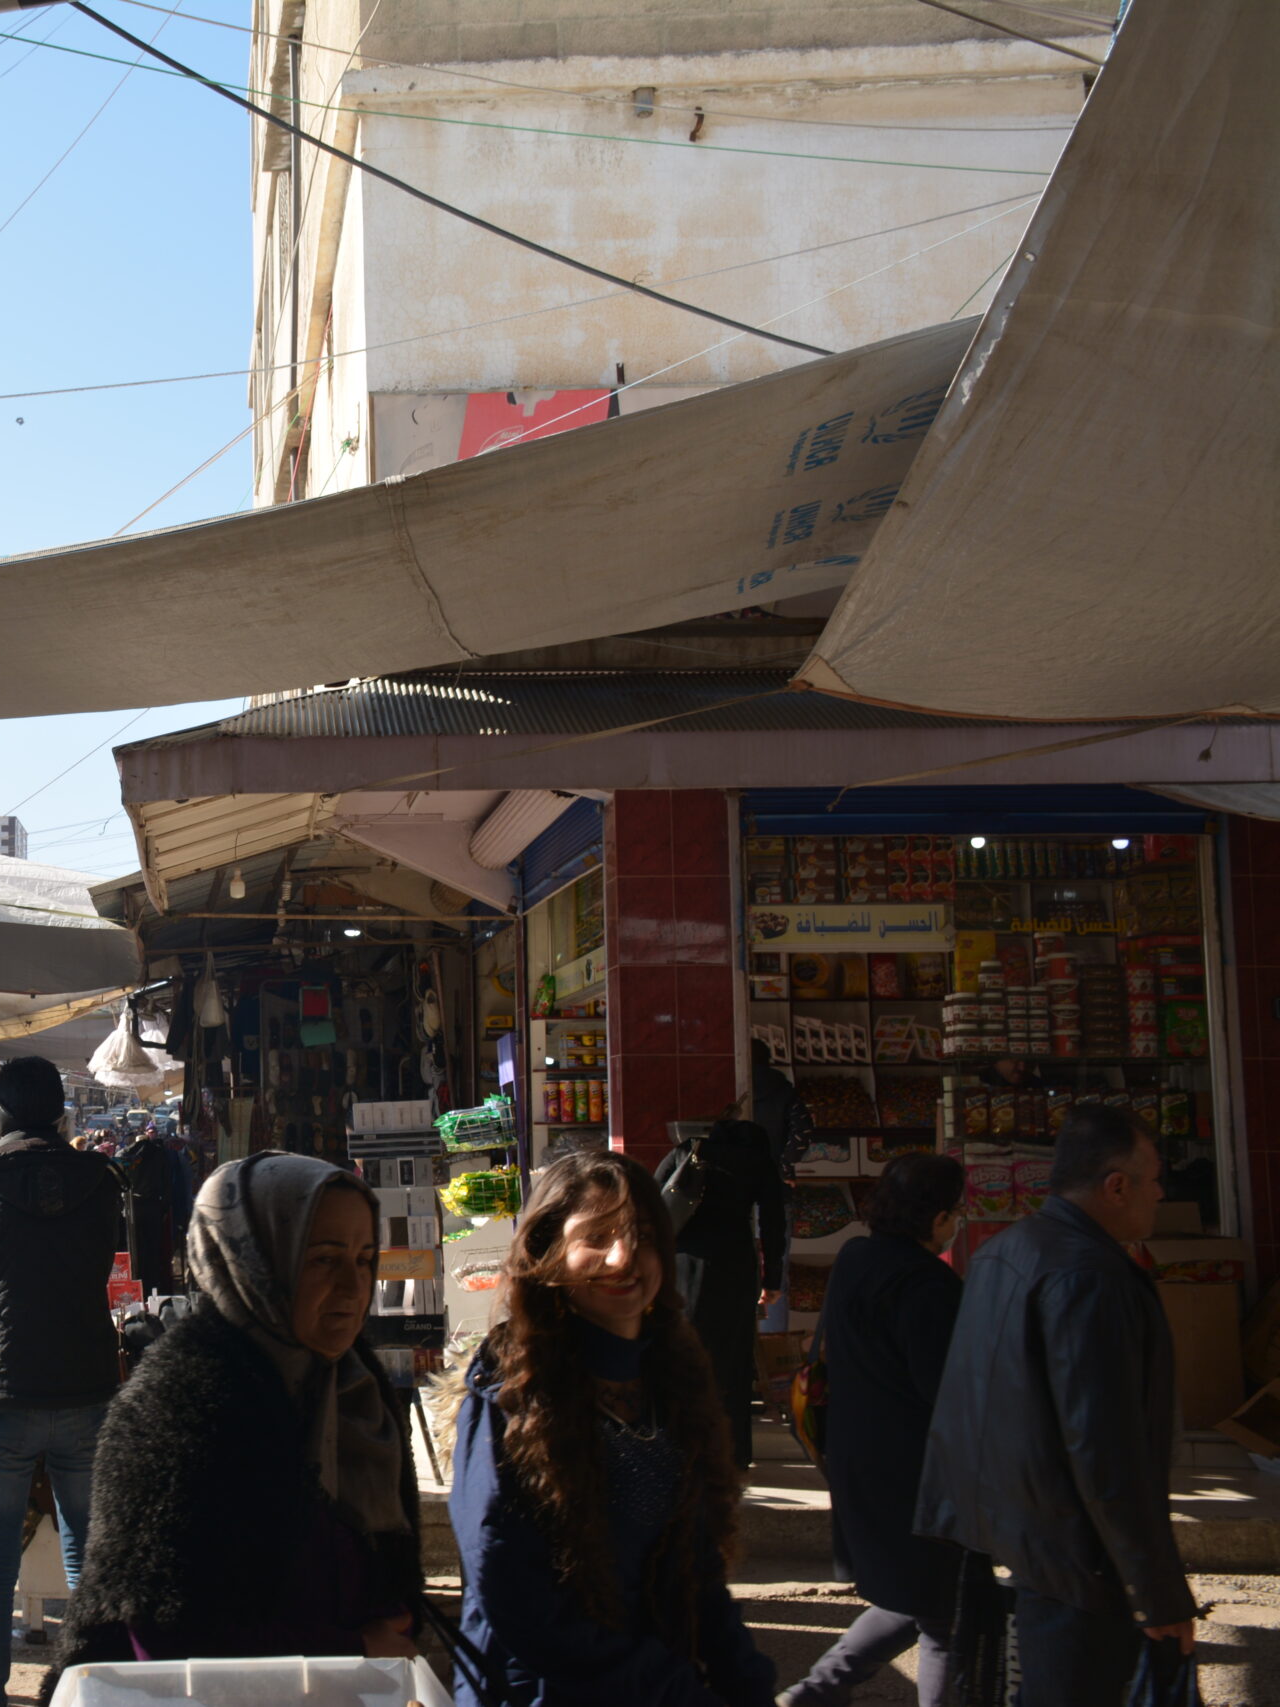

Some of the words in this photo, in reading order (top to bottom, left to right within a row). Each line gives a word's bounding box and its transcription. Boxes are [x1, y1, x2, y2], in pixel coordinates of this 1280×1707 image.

[795, 911, 872, 936] للضيافة
[878, 909, 940, 939] الحسن
[1076, 917, 1127, 936] الحسن
